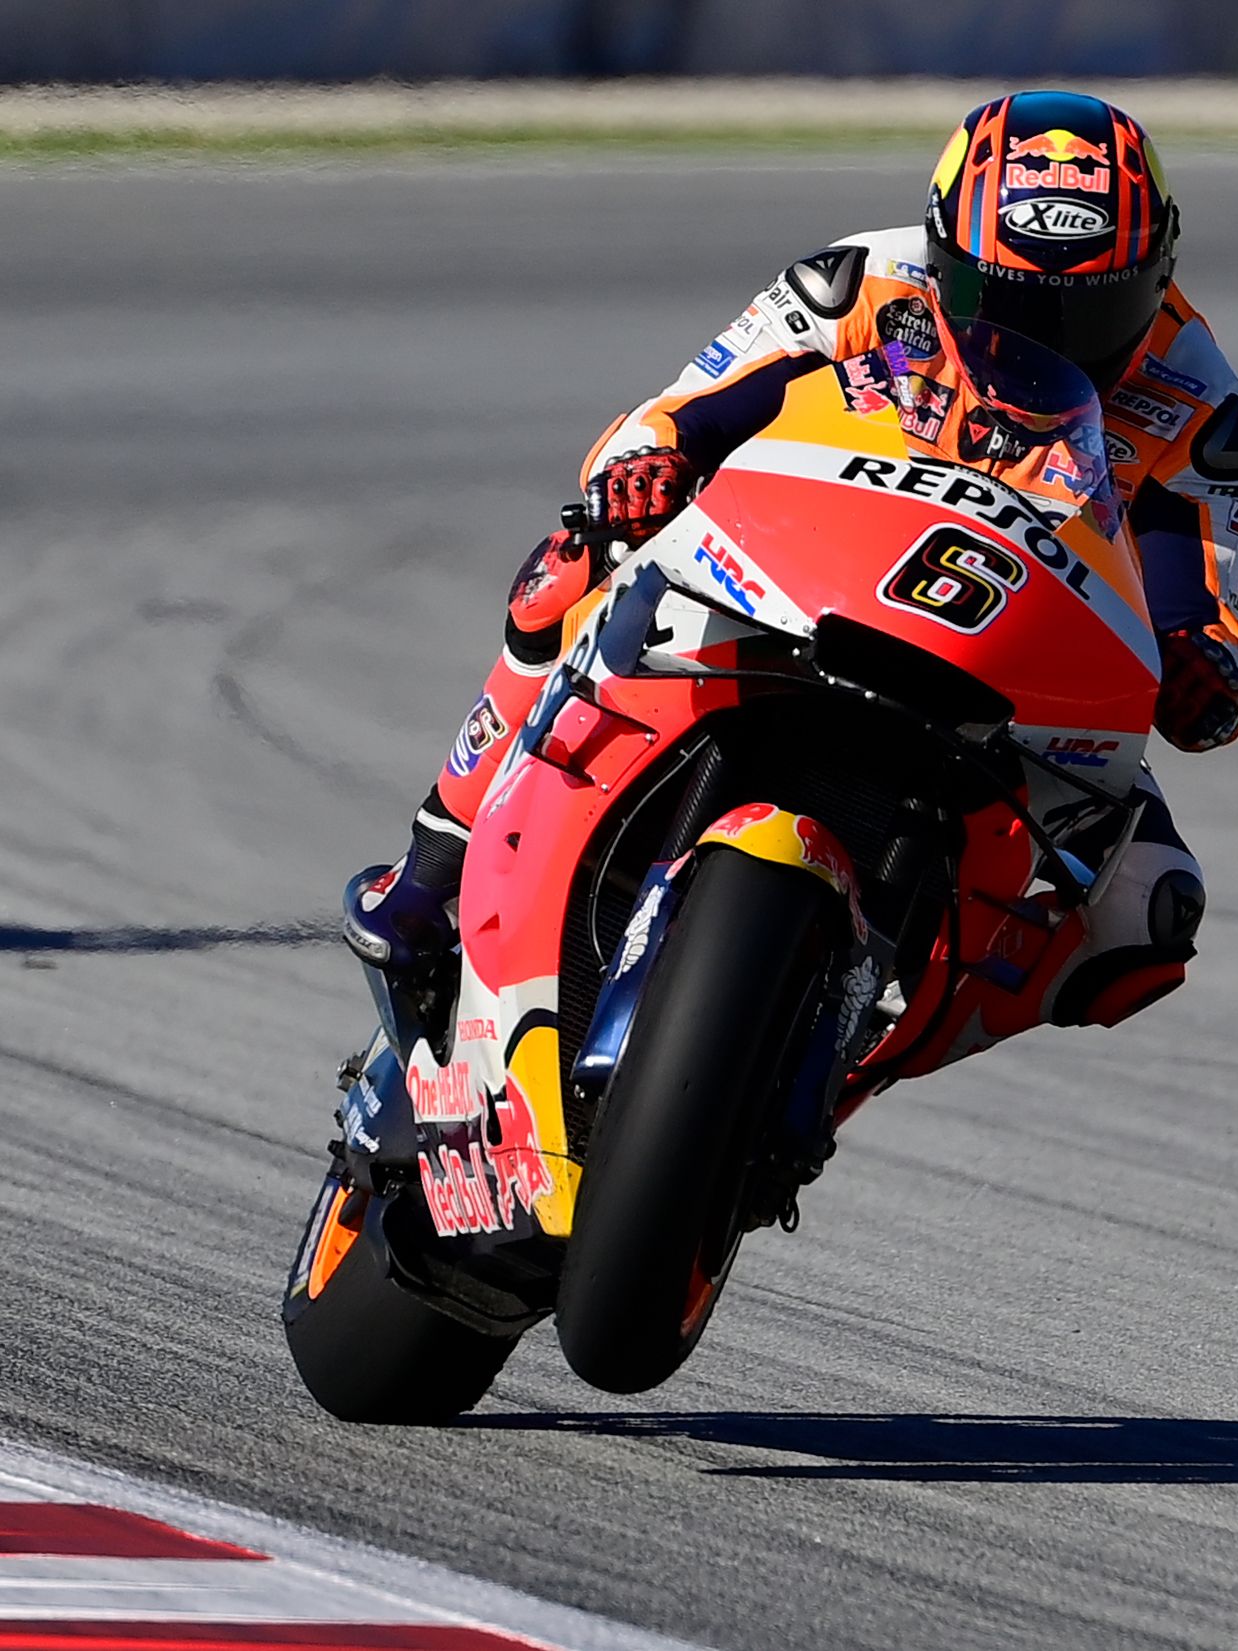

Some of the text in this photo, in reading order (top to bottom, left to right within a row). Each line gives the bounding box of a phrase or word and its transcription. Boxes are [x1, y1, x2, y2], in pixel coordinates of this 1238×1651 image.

[1016, 202, 1098, 231] X-lite
[976, 260, 1140, 288] GIVES YOU WINGS
[884, 320, 932, 352] Galicia
[885, 303, 937, 338] Estrella
[1110, 390, 1181, 427] REPSOL
[838, 456, 1091, 601] REPSOL
[693, 531, 767, 618] HRC
[875, 521, 1030, 636] 6
[1041, 736, 1120, 768] HRC
